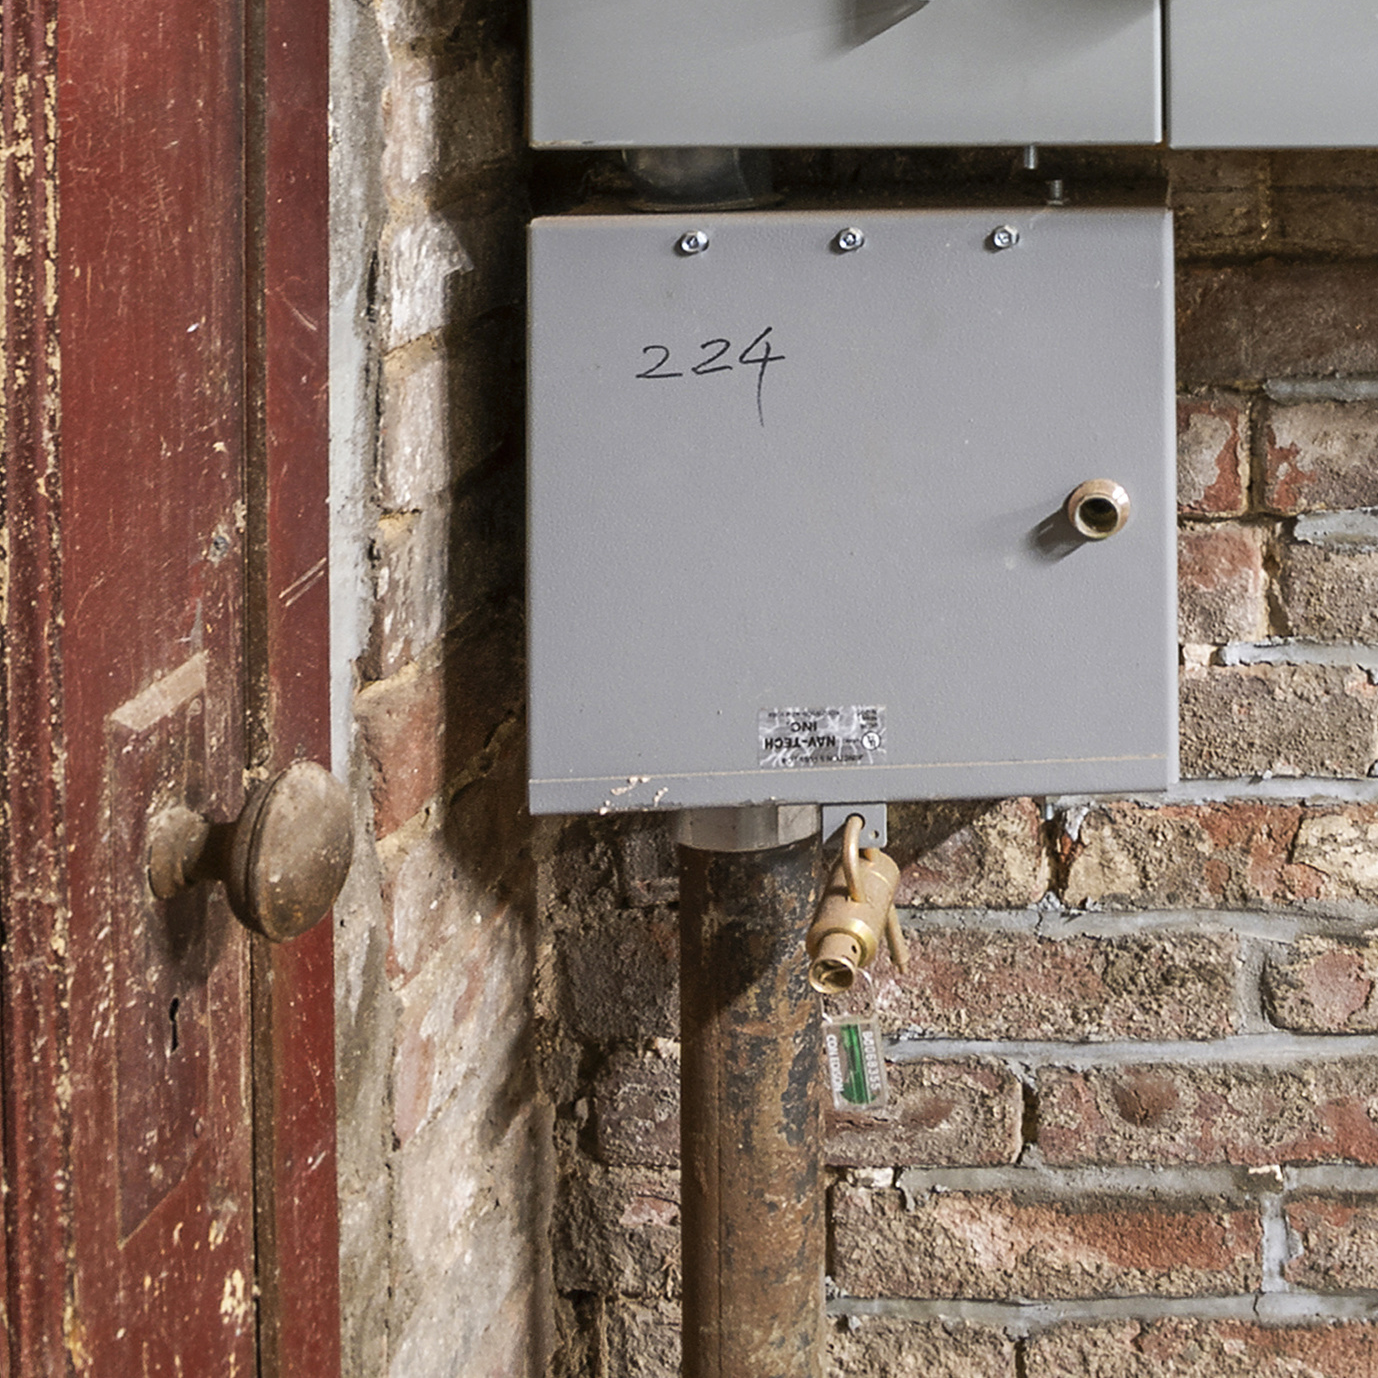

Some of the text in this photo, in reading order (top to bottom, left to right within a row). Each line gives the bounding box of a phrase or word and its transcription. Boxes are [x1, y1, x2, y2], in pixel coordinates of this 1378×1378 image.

[635, 326, 786, 426] 224
[787, 721, 817, 732] INC.
[764, 735, 836, 750] NAV-TECH
